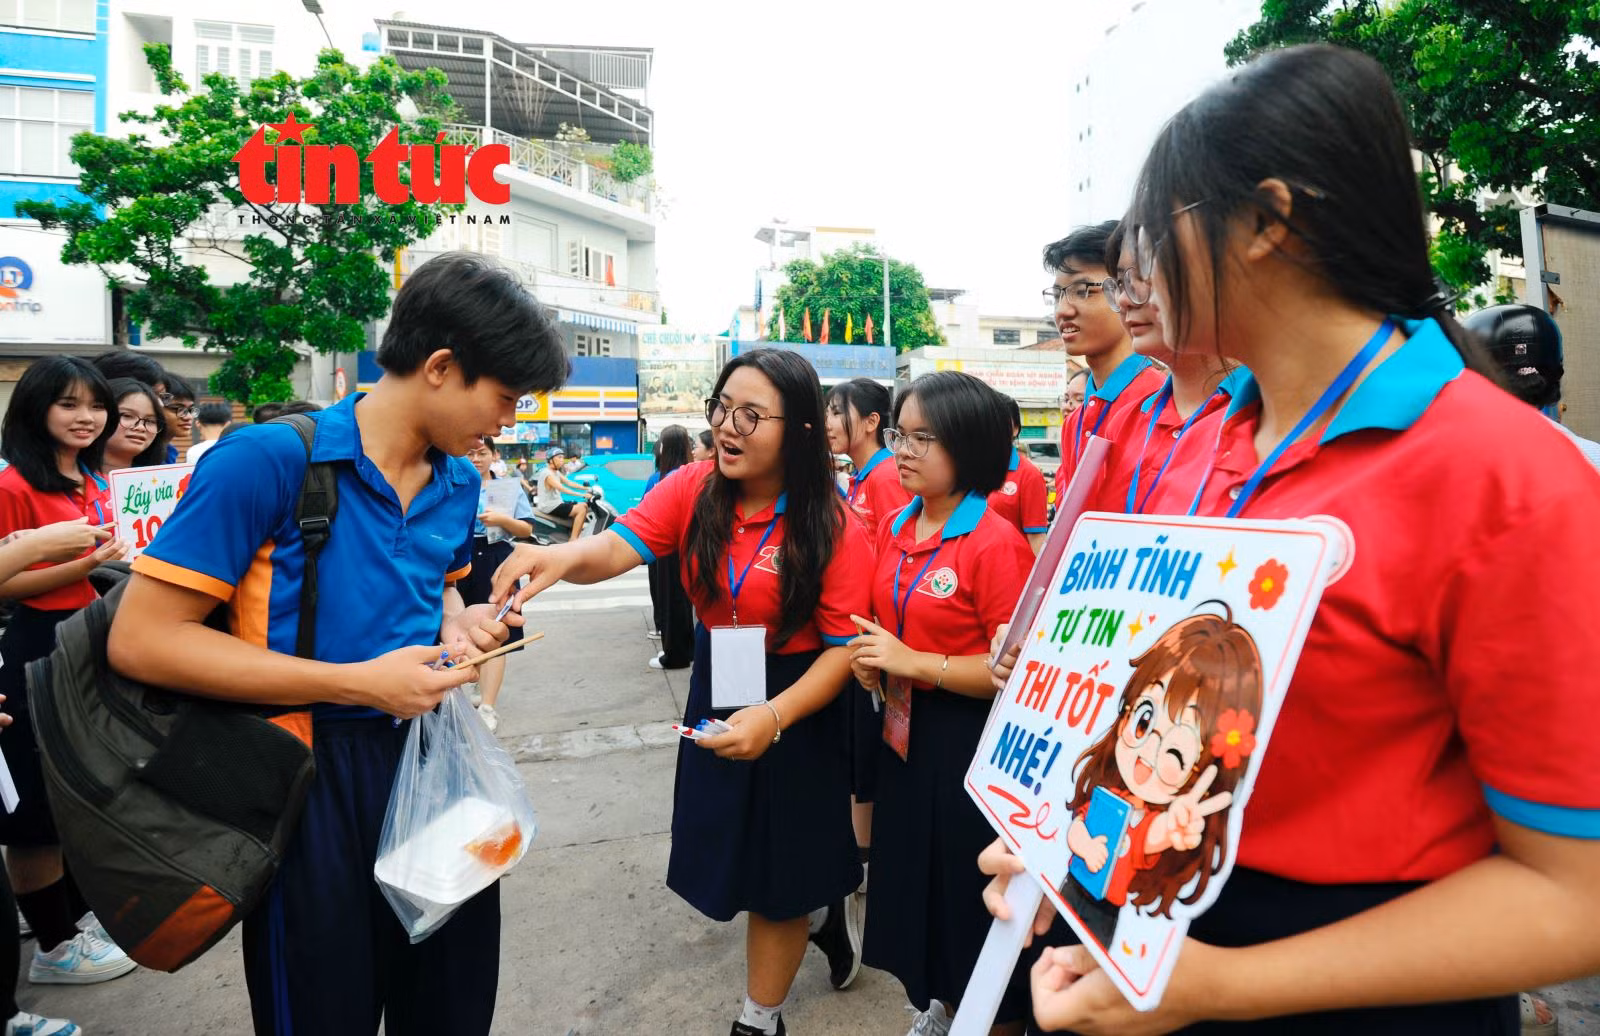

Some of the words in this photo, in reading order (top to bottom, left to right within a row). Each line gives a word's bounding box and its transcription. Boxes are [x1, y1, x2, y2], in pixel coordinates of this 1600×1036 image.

[122, 482, 152, 515] Lấy
[155, 480, 174, 502] vía
[1059, 540, 1128, 595] BÌNH
[1127, 535, 1202, 600] TĨNH
[1049, 604, 1087, 653] TỰ
[1081, 608, 1125, 648] TIN
[1015, 660, 1062, 713] THI
[1055, 660, 1115, 736] TỐT
[990, 721, 1062, 796] NHÉ!
